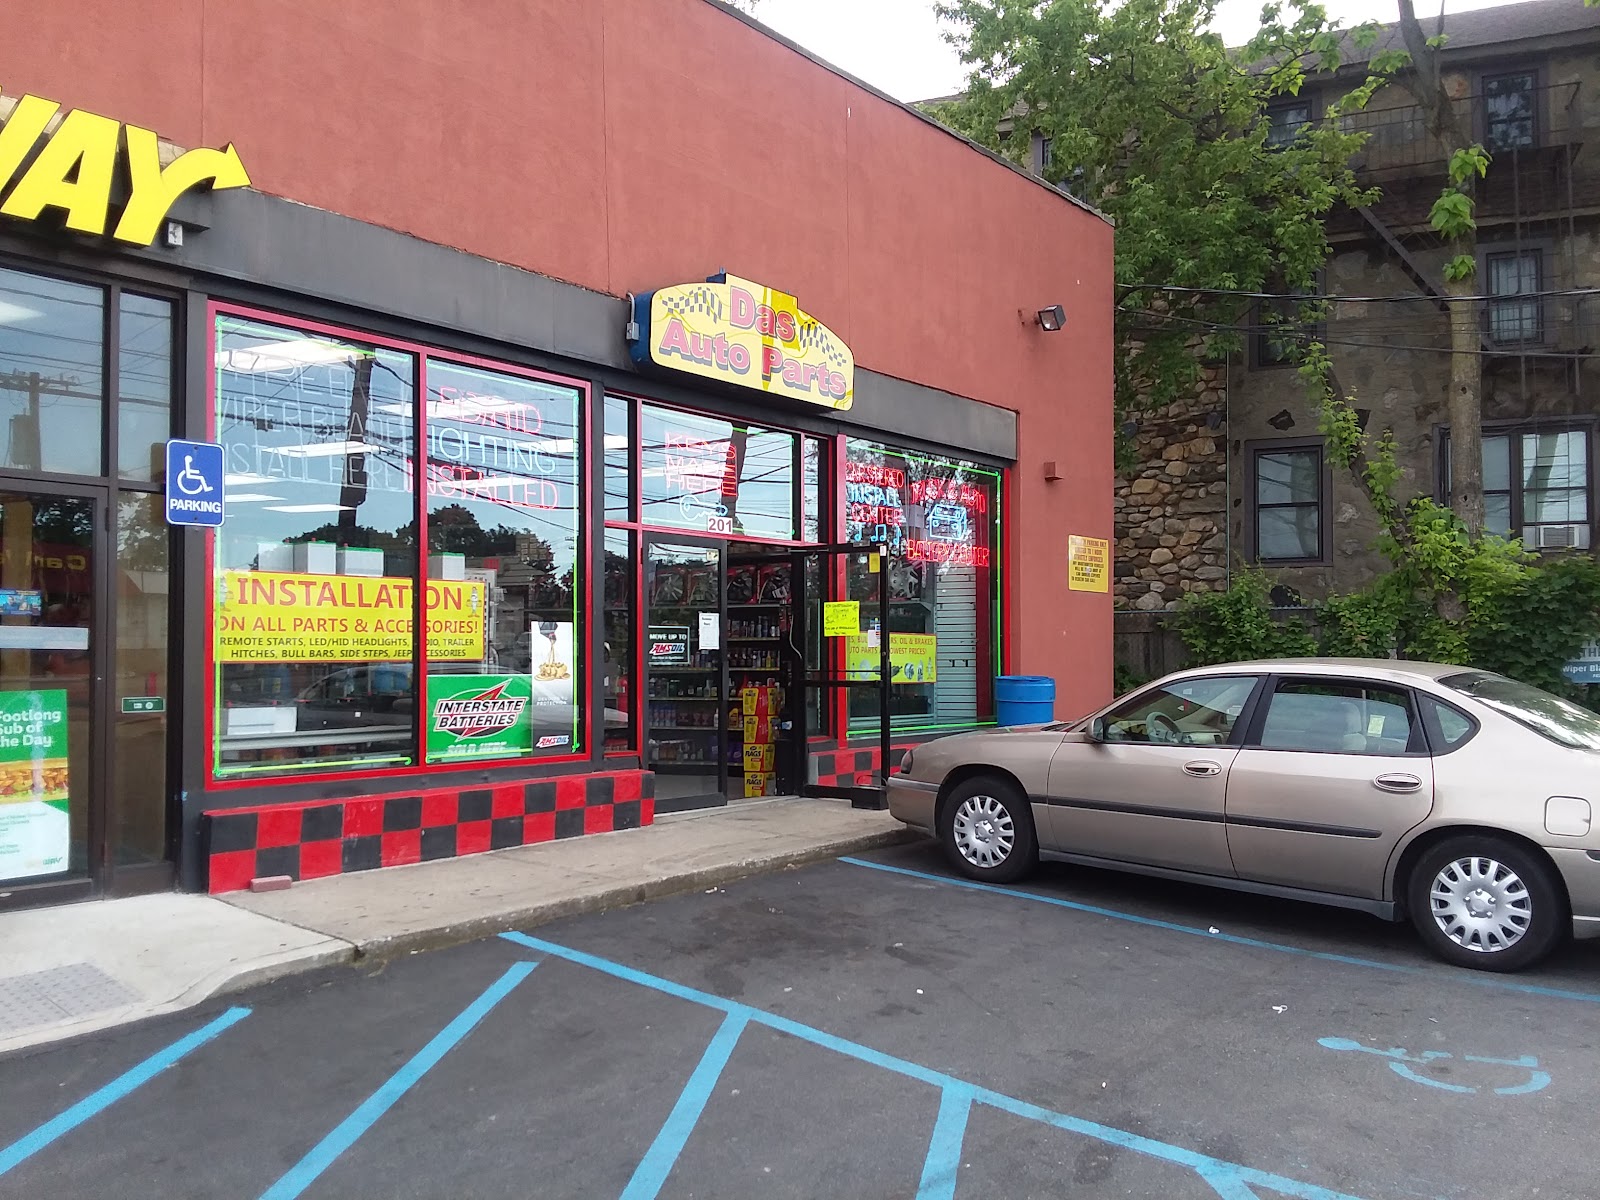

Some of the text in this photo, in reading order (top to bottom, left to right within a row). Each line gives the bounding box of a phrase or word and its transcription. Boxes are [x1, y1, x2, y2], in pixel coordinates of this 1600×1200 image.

[730, 286, 796, 342] Das
[659, 318, 847, 400] Auto Parts
[430, 424, 556, 473] IGHTING
[666, 432, 738, 459] KEYS
[224, 442, 310, 483] STALL
[667, 474, 739, 497] HERE
[850, 483, 902, 508] INSTALL
[169, 498, 222, 514] PARKING
[851, 503, 904, 527] CENTER
[708, 518, 733, 533] 201
[237, 577, 462, 610] INSTALLATON
[215, 615, 479, 634] ON ALL PARTS & ACCESORIES!
[219, 637, 264, 646] REMOTE
[266, 637, 306, 647] STARTS,
[309, 638, 349, 647] LED/HID
[352, 638, 410, 647] HEADLIGHTS,
[443, 638, 475, 646] TRAILER
[652, 644, 684, 654] AMSOIL
[914, 638, 934, 646] BRAKES
[231, 649, 466, 659] HITCHES, BULL BARS, SIDE STEPS, JEEP CESSORIES
[861, 646, 878, 655] PARTS
[890, 647, 907, 655] OWEST
[1562, 664, 1587, 674] Wiper
[437, 700, 523, 714] INTERSTATE
[26, 720, 43, 733] of
[438, 713, 518, 728] BATTERIES
[0, 734, 53, 748] he Day
[539, 736, 568, 747] AMSOIL
